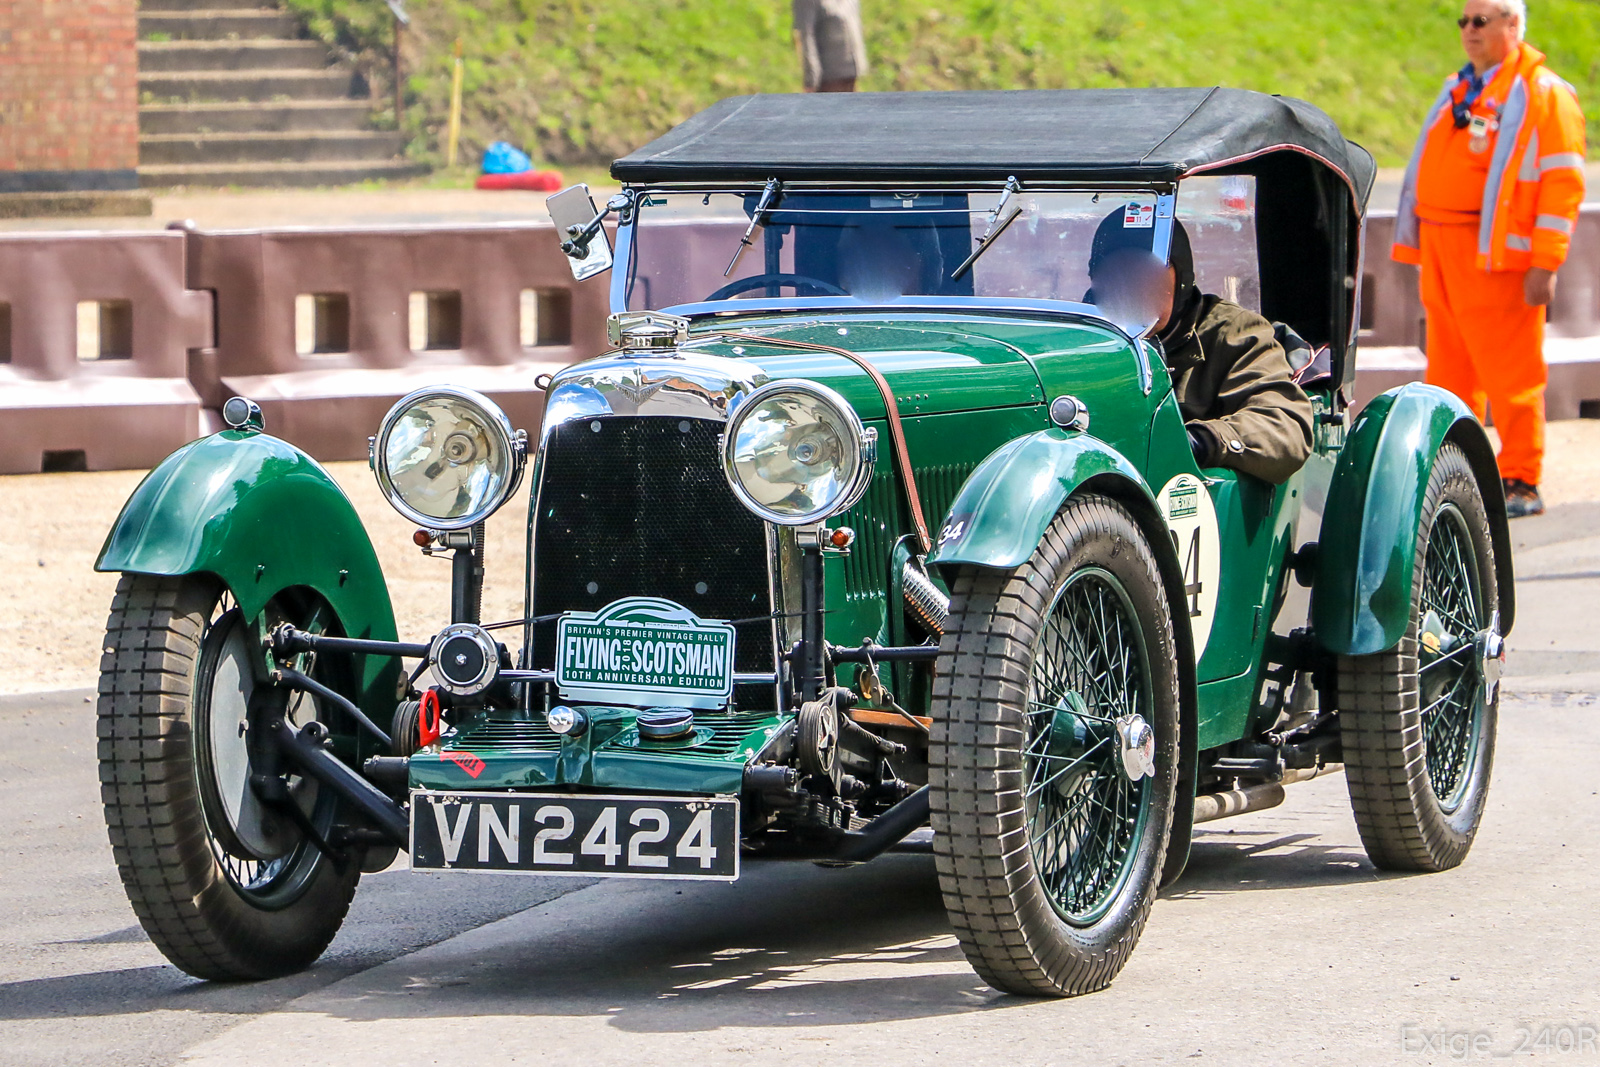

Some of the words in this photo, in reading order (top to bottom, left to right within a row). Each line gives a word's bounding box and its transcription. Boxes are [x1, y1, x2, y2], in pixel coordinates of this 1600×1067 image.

[938, 521, 965, 545] 34
[567, 626, 611, 636] BRITAIN'S
[615, 629, 653, 639] PREMIER
[657, 631, 694, 641] VINTAGE
[697, 633, 725, 643] RALLY
[565, 636, 622, 671] FLYING
[631, 640, 724, 677] SCOTSMAN
[621, 639, 632, 671] 2018
[565, 670, 592, 680] 10TH
[597, 671, 674, 685] ANNIVERSARY
[679, 676, 723, 688] EDITION
